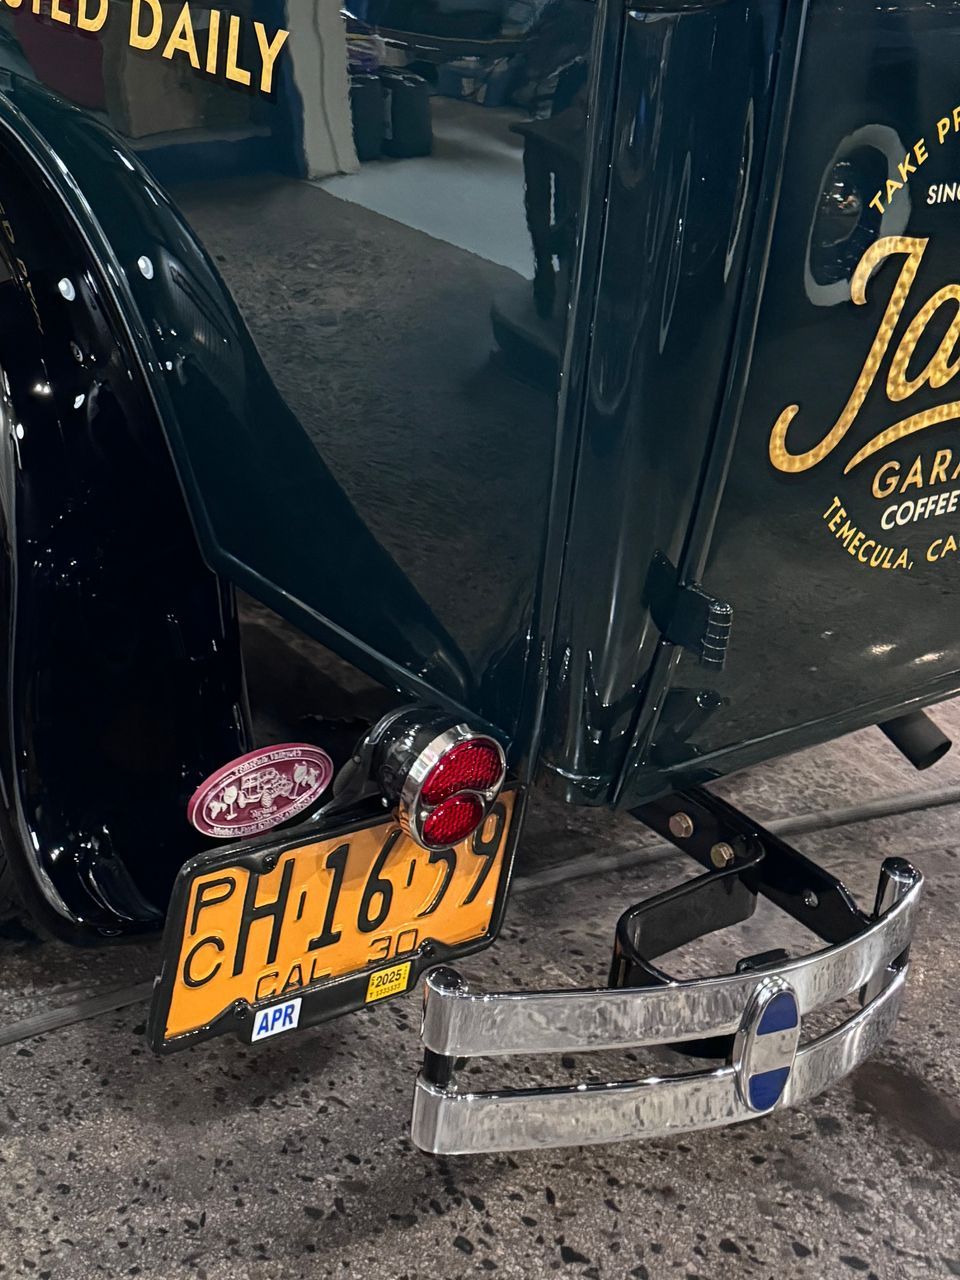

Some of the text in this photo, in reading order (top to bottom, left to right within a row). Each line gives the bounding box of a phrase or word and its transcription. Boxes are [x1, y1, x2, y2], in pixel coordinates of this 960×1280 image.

[869, 137, 929, 216] TAKE
[927, 182, 960, 205] SIN
[881, 490, 960, 530] COFFEE
[823, 496, 960, 570] TEMECULA, CA
[255, 928, 418, 1001] CAL 30
[375, 969, 403, 988] 2025
[257, 1003, 295, 1036] APR
